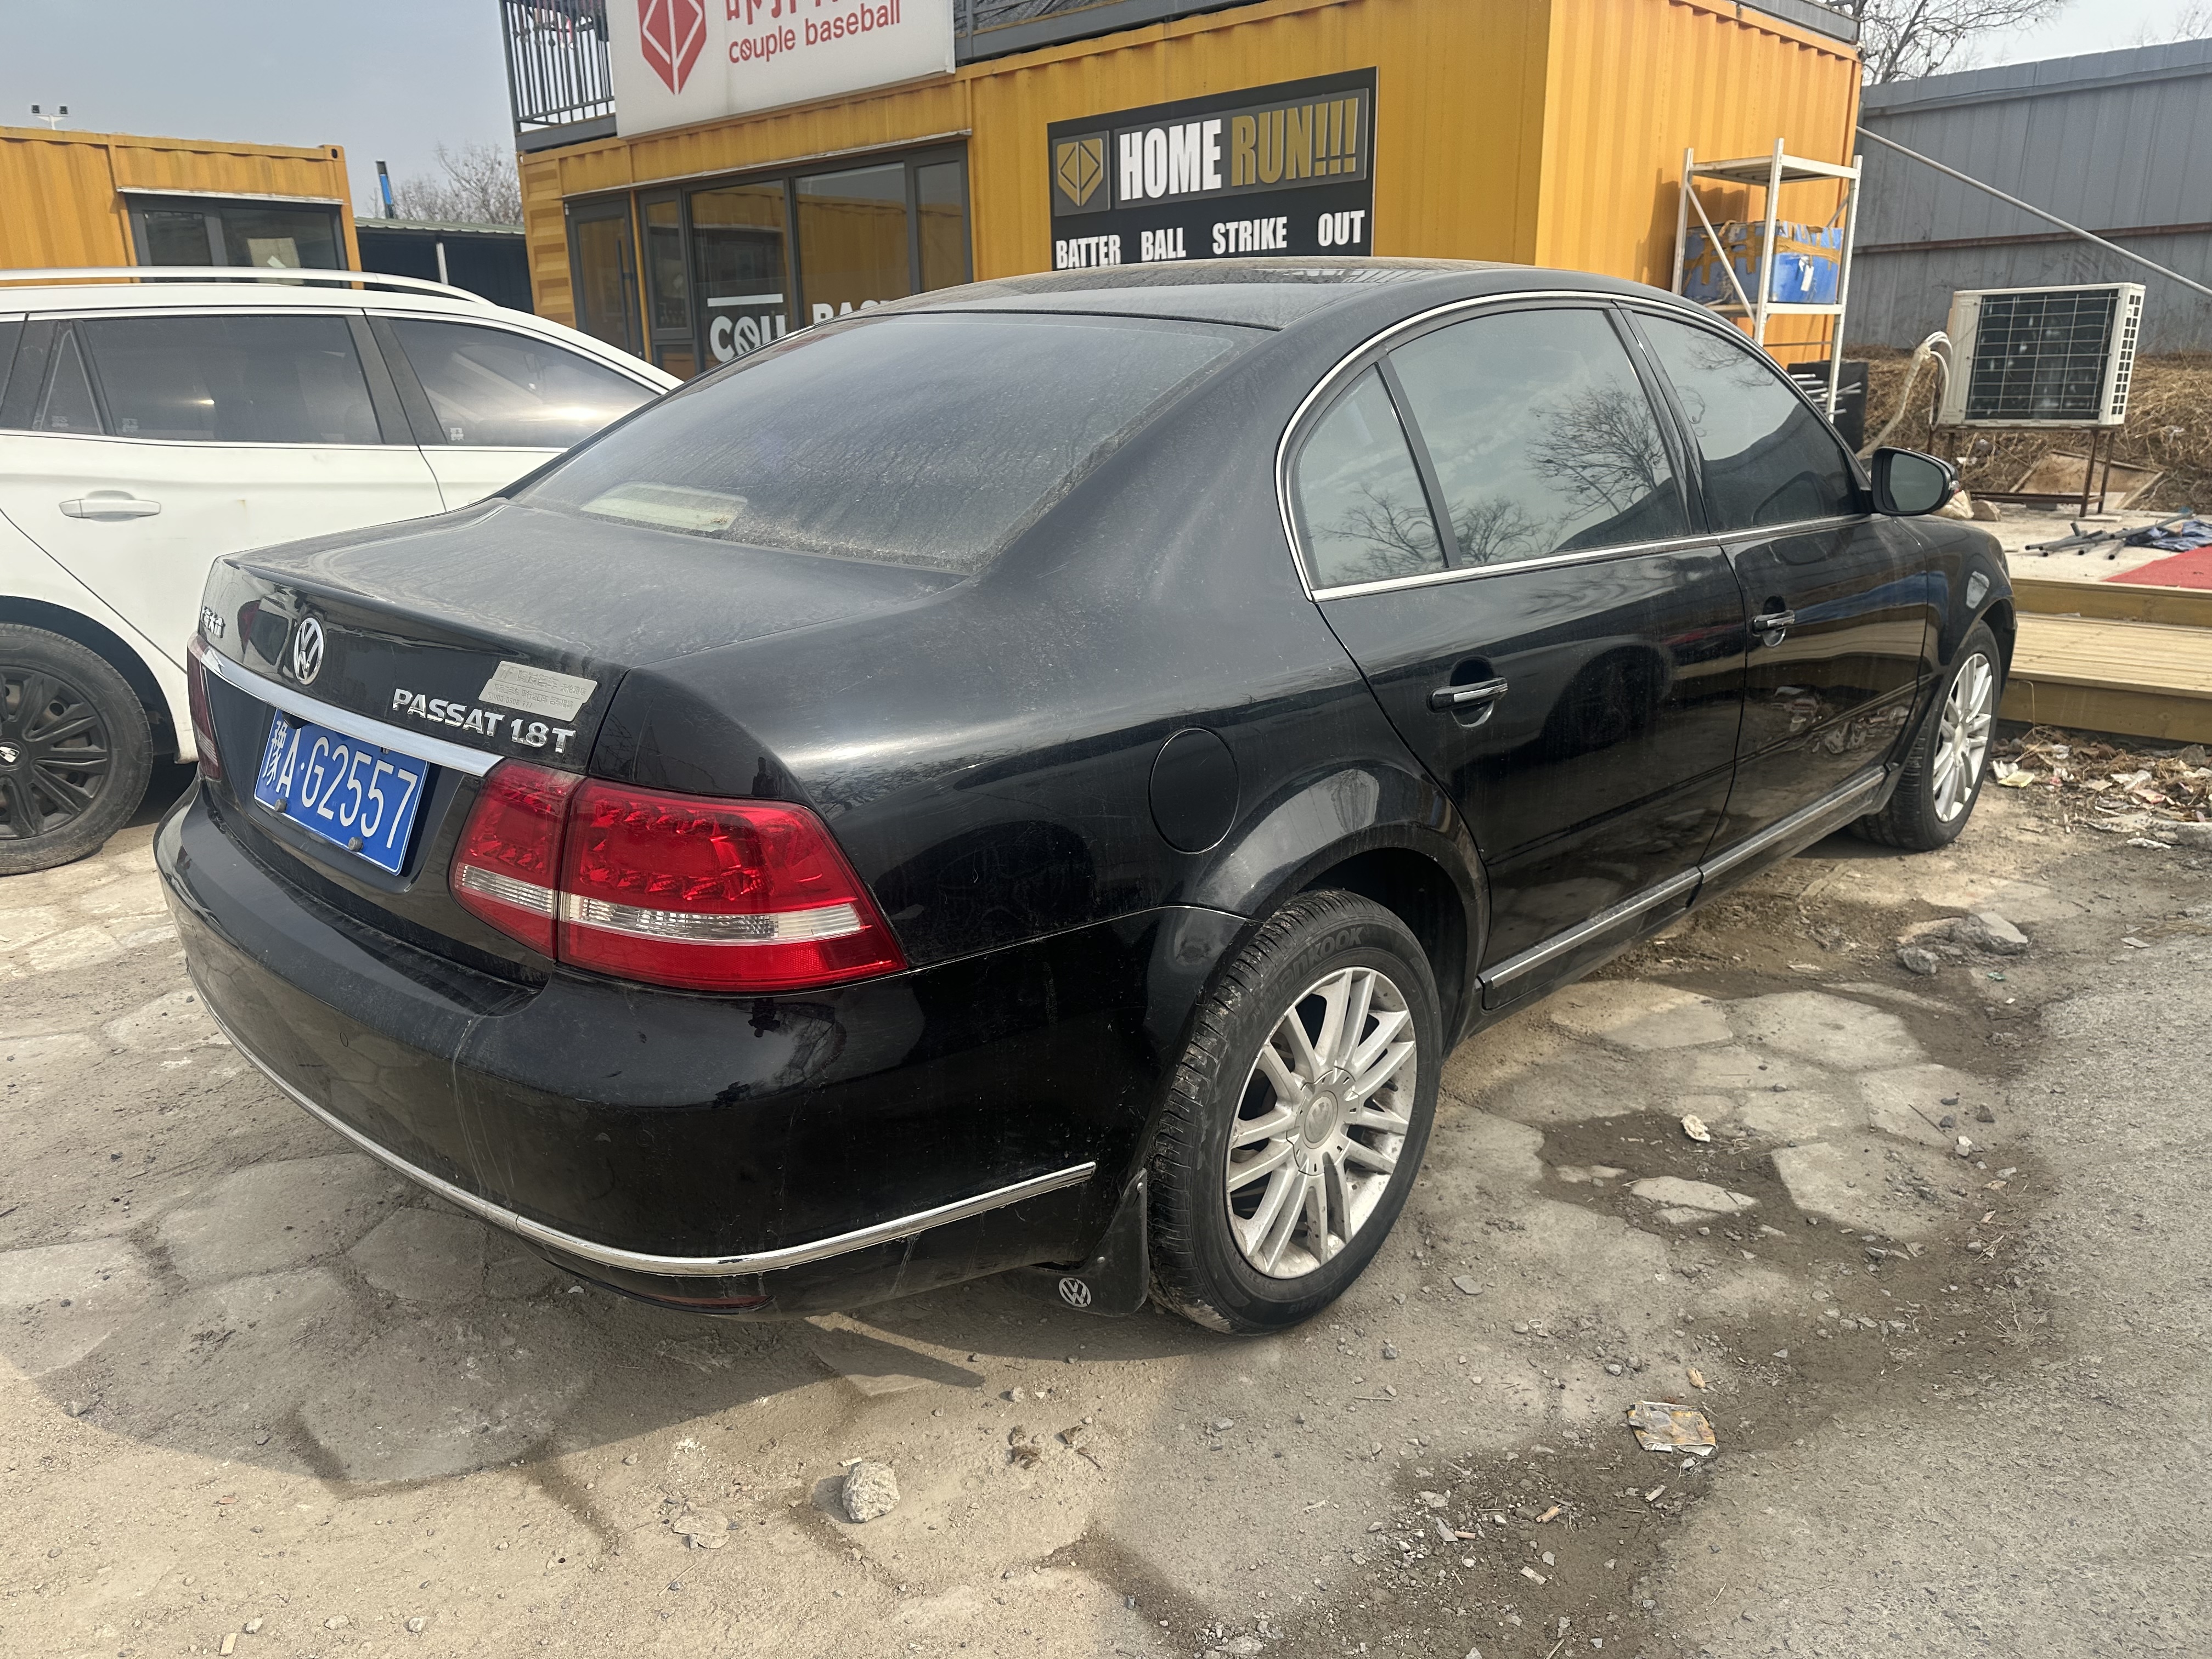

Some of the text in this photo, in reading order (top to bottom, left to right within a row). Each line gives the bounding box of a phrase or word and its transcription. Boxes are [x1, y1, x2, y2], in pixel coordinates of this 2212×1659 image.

[729, 25, 796, 64] couple
[805, 0, 901, 46] baseball
[1119, 97, 1359, 201] HOME RUN!!!
[1056, 210, 1366, 269] BATTER BALL STRIKE OUT
[392, 688, 505, 737] PASSAT
